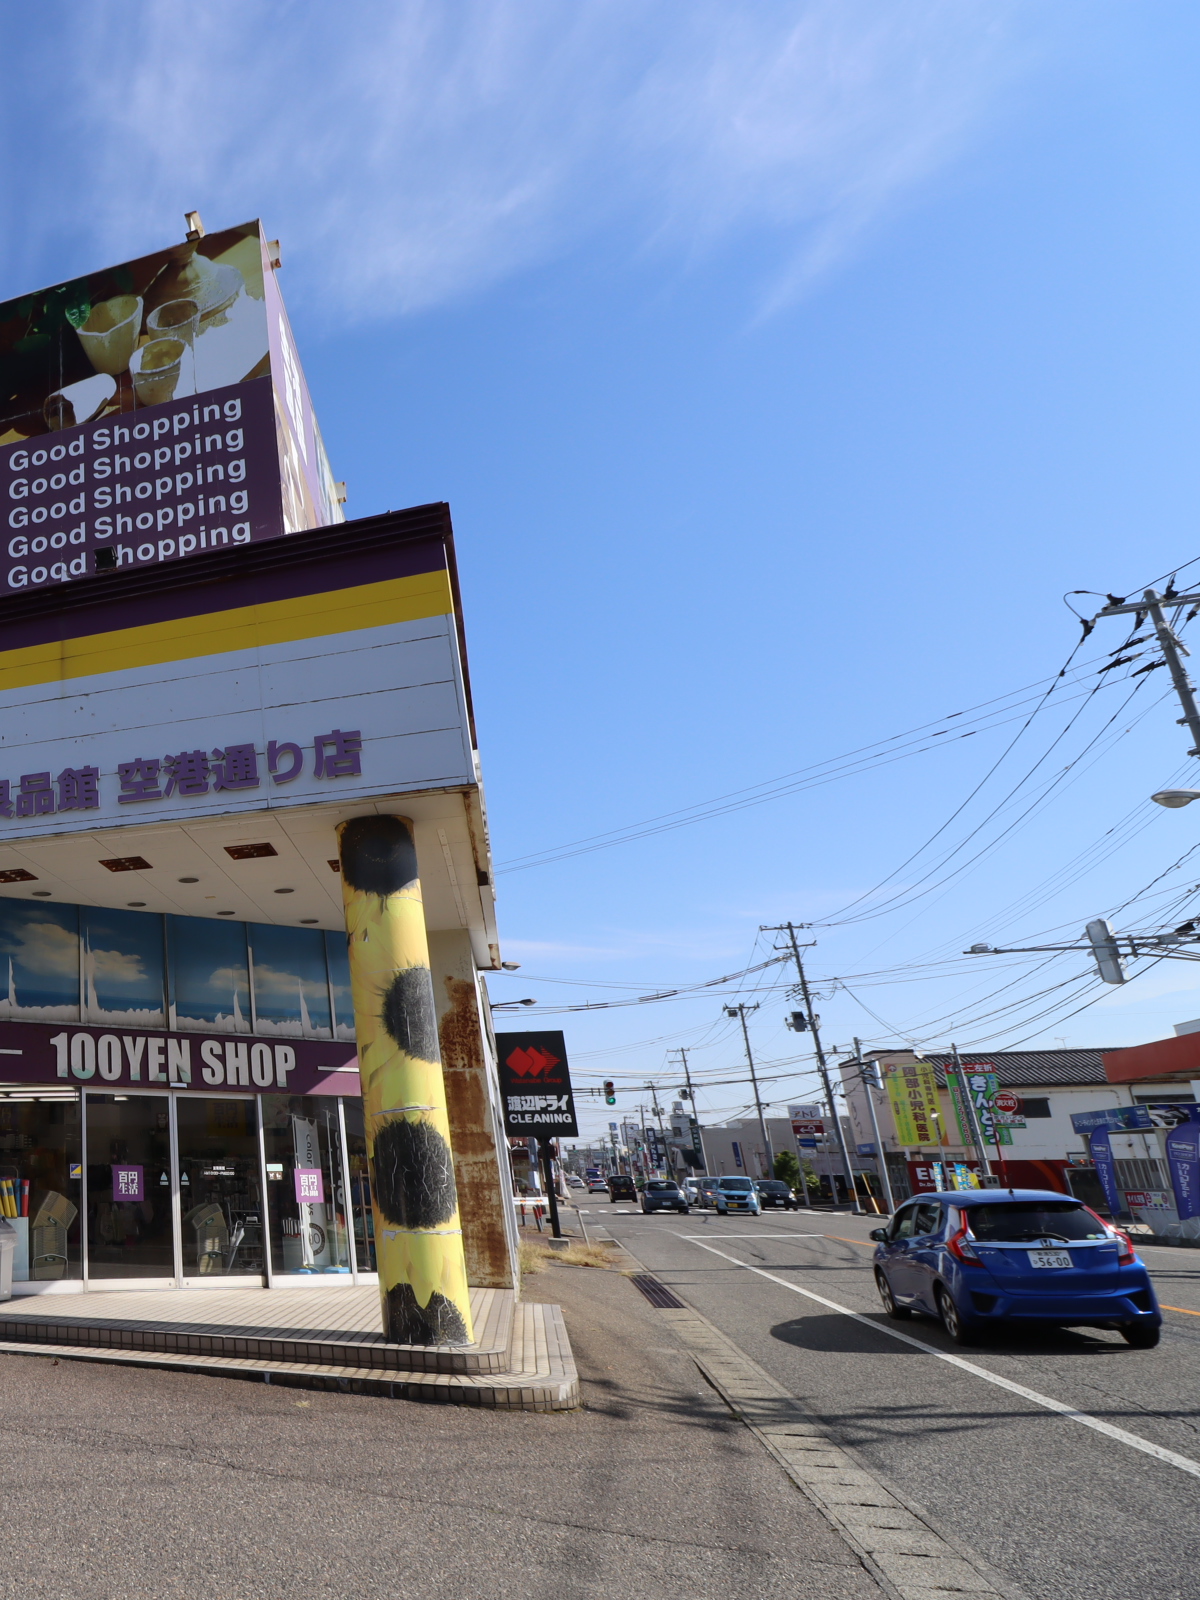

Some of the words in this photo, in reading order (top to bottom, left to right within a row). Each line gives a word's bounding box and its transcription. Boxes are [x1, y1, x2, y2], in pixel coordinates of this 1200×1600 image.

[8, 434, 86, 472] Good
[92, 397, 244, 451] Shopping
[7, 461, 86, 501] Good
[92, 427, 246, 481] Shopping
[7, 492, 86, 530] Good
[93, 459, 248, 510] Shopping
[6, 522, 87, 559] Good
[94, 487, 250, 540] Shopping
[6, 552, 87, 589] Good
[95, 521, 252, 568] hopping
[116, 728, 364, 804] 空港通り店
[49, 1031, 192, 1084] 100YEN
[200, 1040, 297, 1088] SHOP
[506, 1095, 569, 1112] 渡辺ドライ
[508, 1113, 573, 1124] CLEANING
[118, 1171, 138, 1183] 百円
[118, 1183, 139, 1195] 生活
[300, 1174, 318, 1186] 百円
[301, 1185, 319, 1197] 良品
[1038, 1257, 1070, 1266] 56-00
